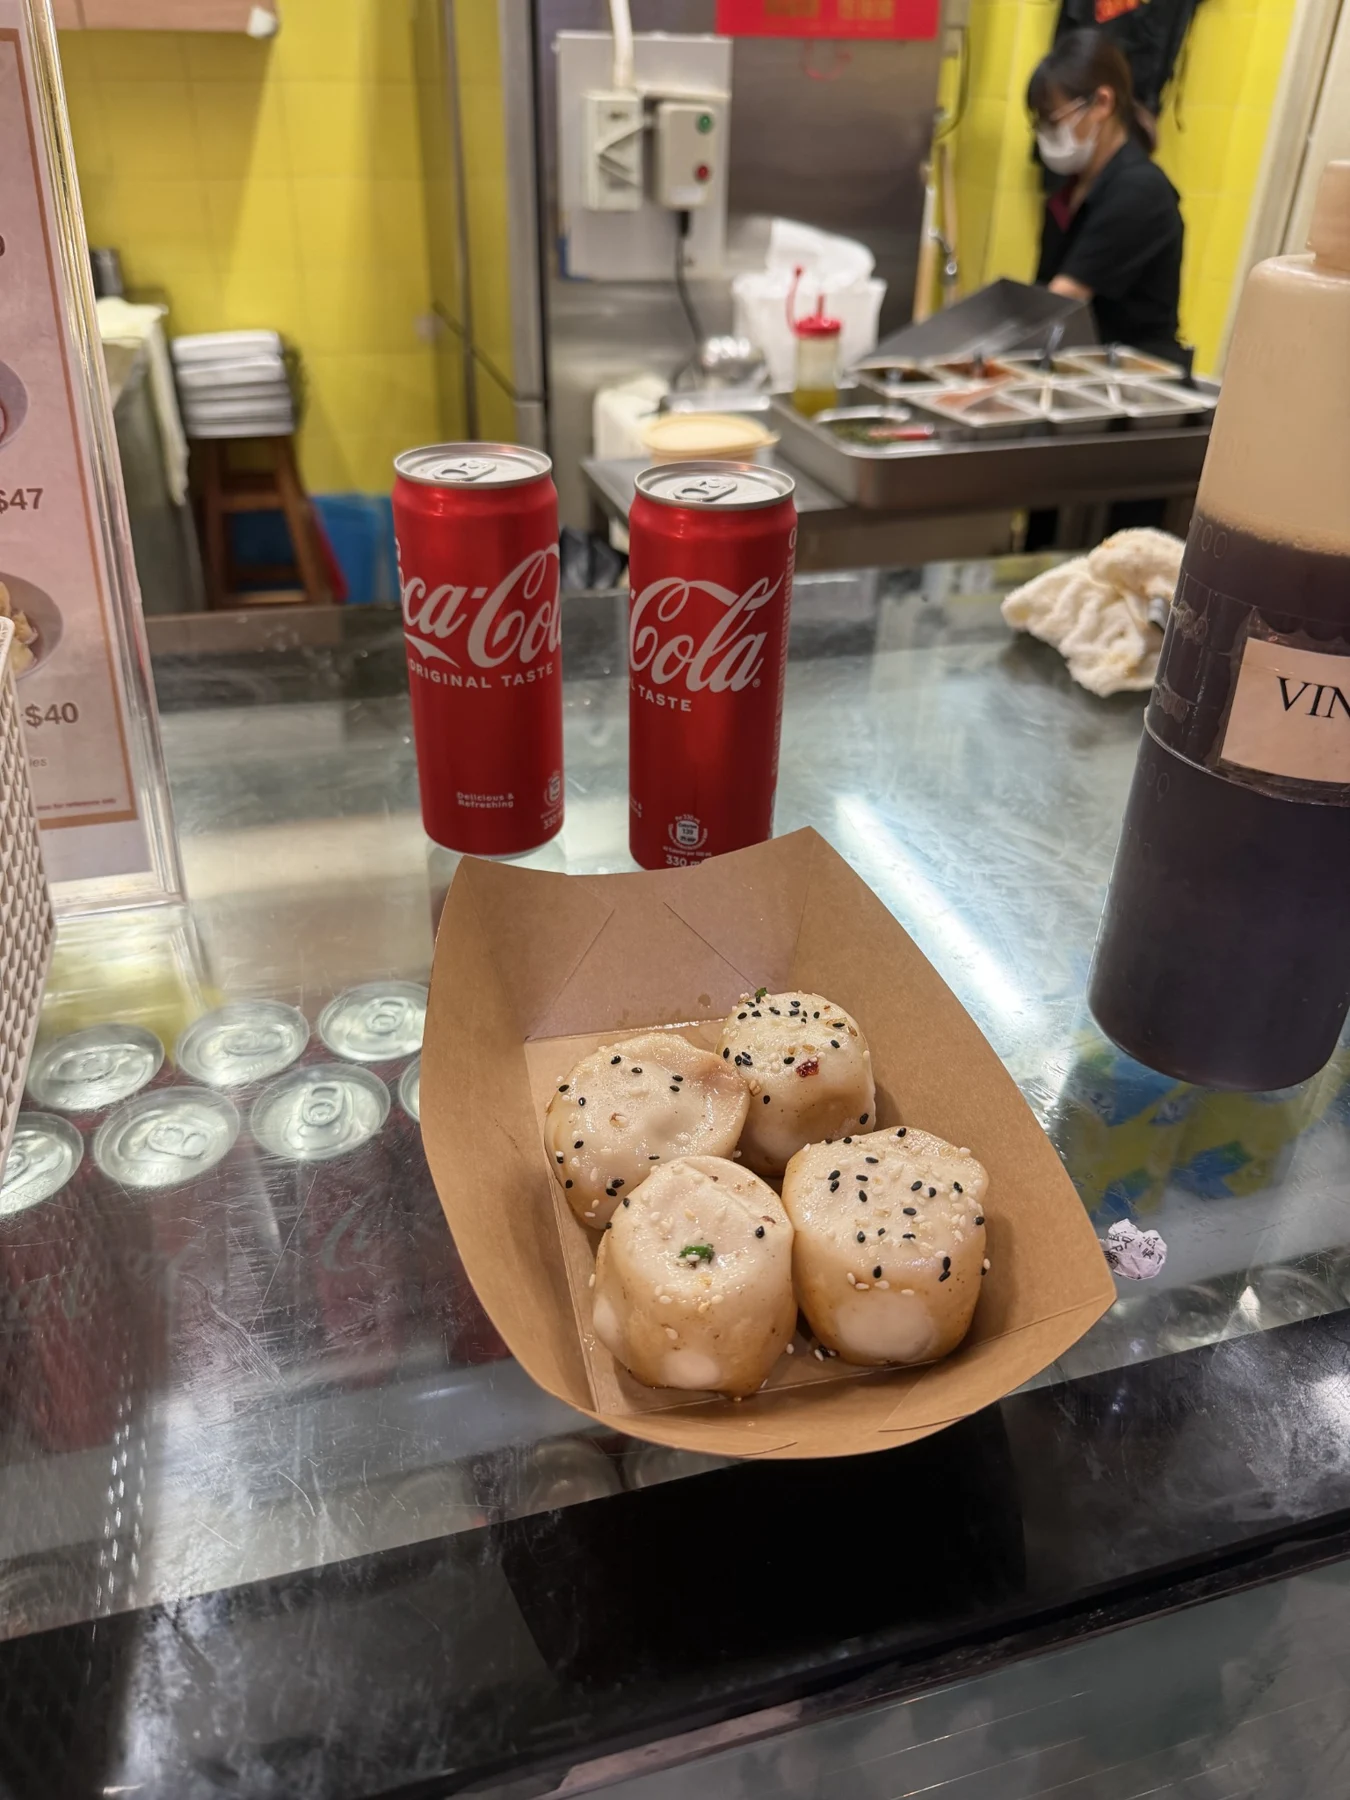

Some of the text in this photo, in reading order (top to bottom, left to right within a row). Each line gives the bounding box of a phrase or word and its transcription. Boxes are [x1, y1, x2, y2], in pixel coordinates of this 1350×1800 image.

[409, 659, 553, 689] ORIGINAL TASTE
[638, 684, 692, 712] TASTE
[24, 702, 79, 728] $40
[457, 792, 504, 802] Delicious
[665, 854, 688, 867] 330
